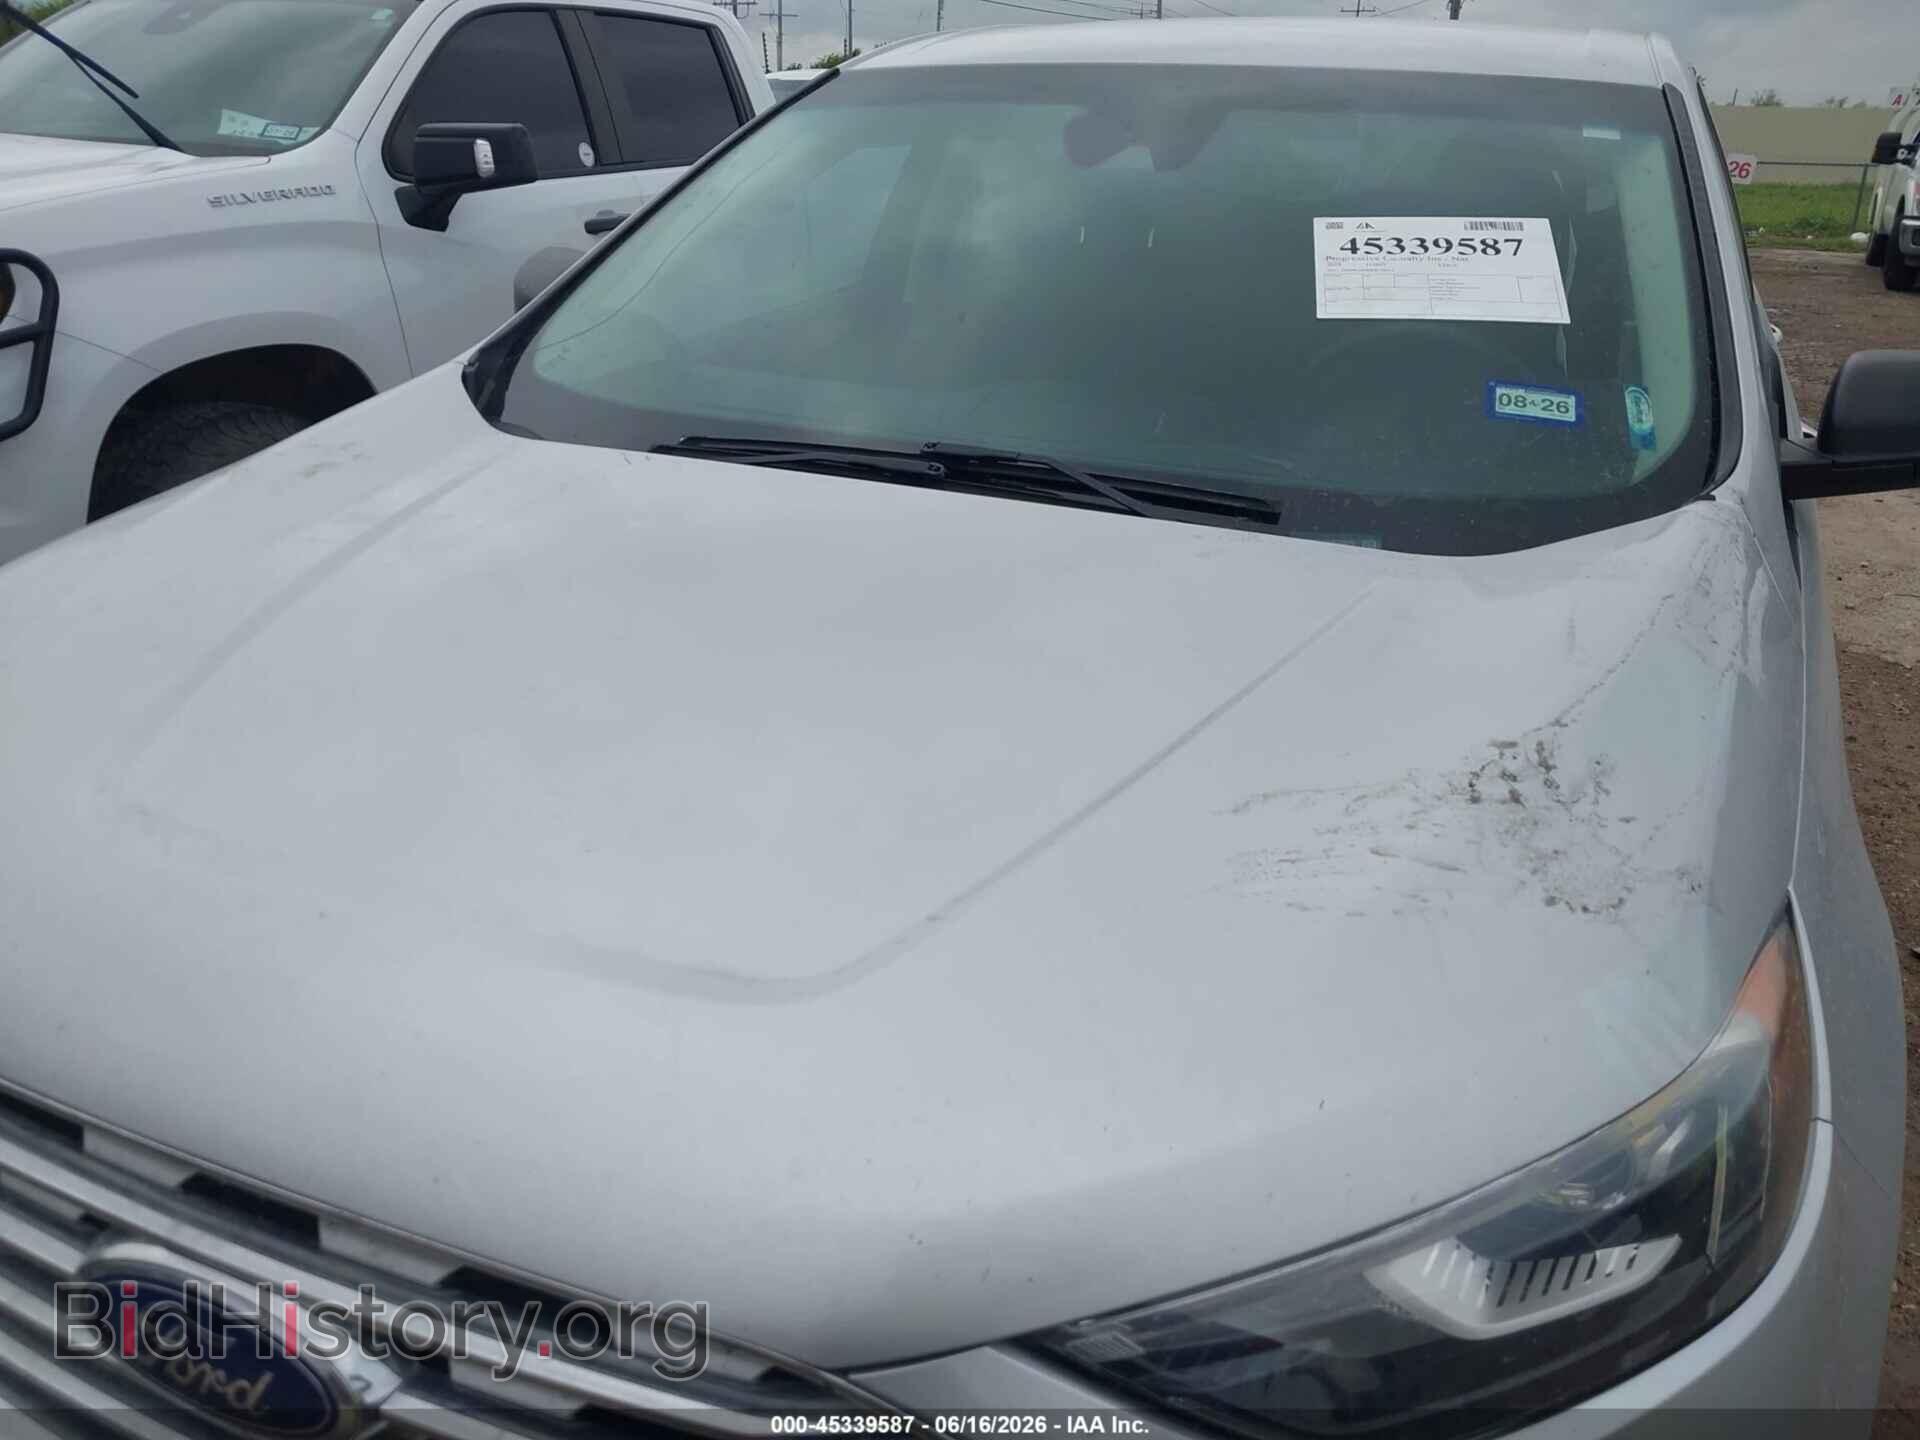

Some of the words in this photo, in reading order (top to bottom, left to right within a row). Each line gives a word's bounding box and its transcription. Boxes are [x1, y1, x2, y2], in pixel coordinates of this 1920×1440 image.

[1729, 160, 1752, 179] 26
[207, 184, 337, 208] SILVERADO
[1339, 236, 1524, 256] 45339587
[1498, 392, 1528, 409] 08
[1541, 398, 1570, 415] 26
